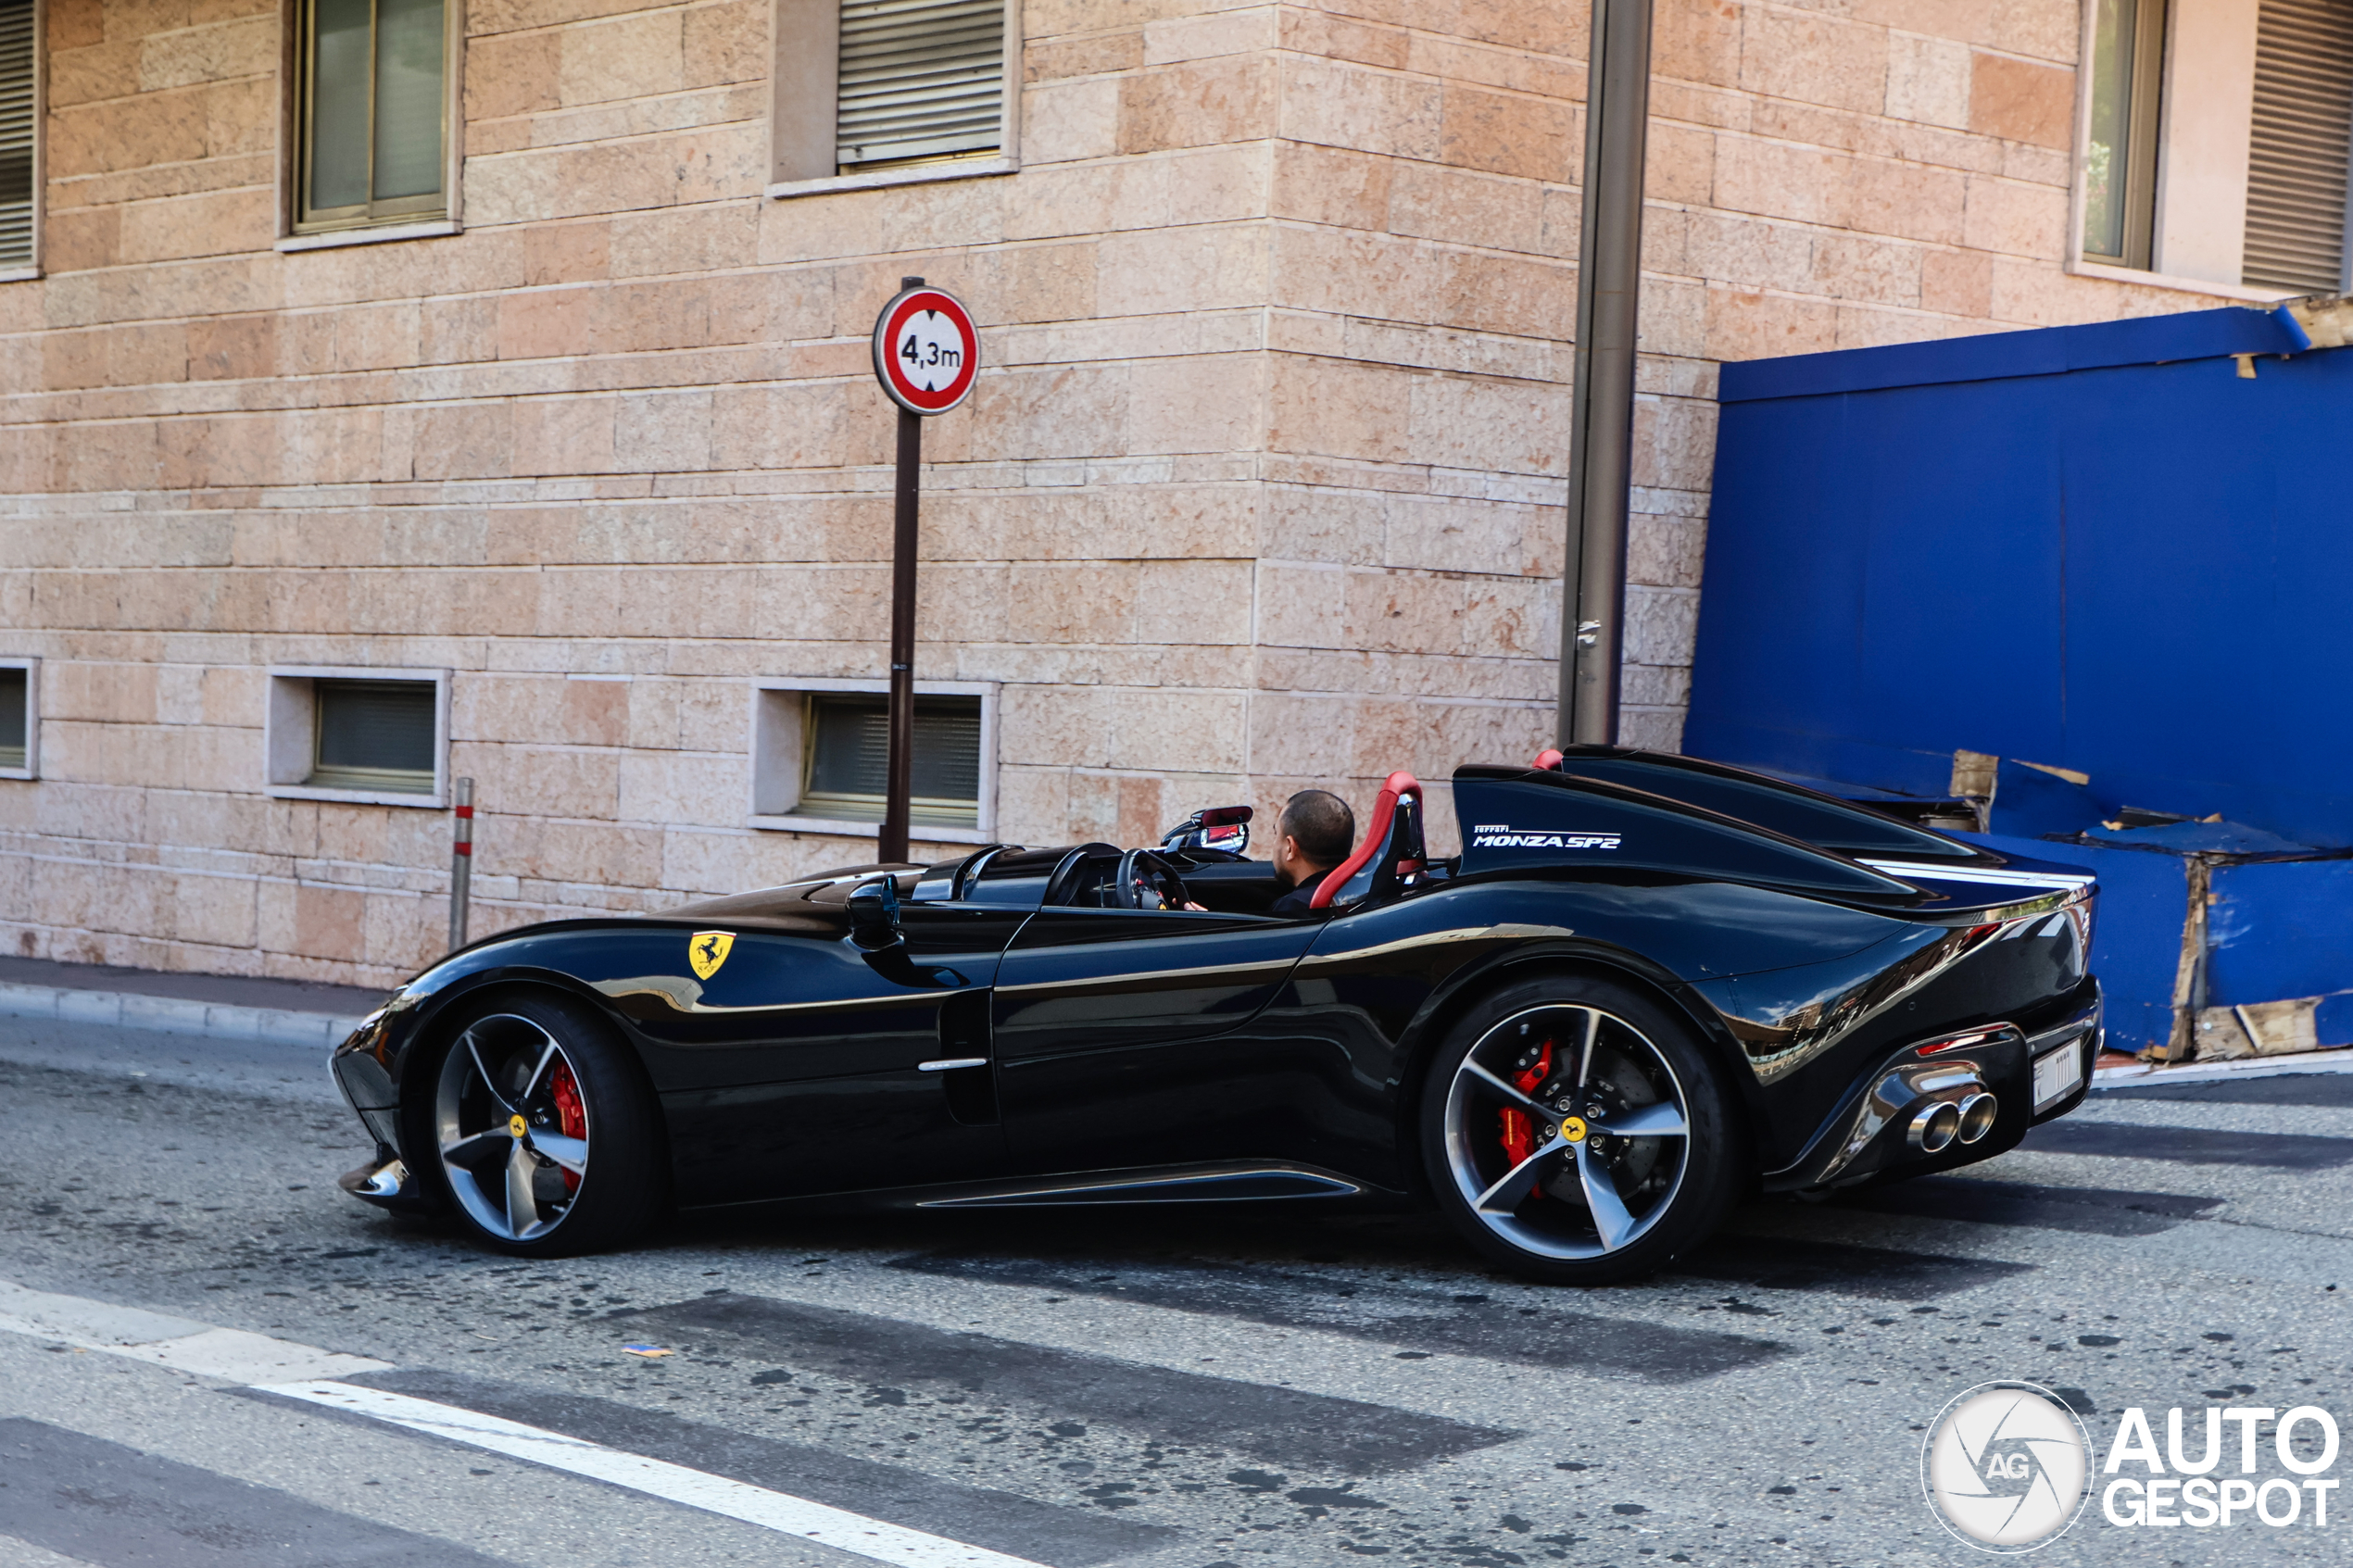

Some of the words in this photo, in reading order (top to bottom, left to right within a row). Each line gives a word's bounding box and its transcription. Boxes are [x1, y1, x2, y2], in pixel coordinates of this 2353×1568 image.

[901, 334, 961, 370] 4,3m
[1473, 824, 1509, 834] Ferrari
[1472, 835, 1564, 847] MONZA
[1565, 836, 1621, 849] SP2
